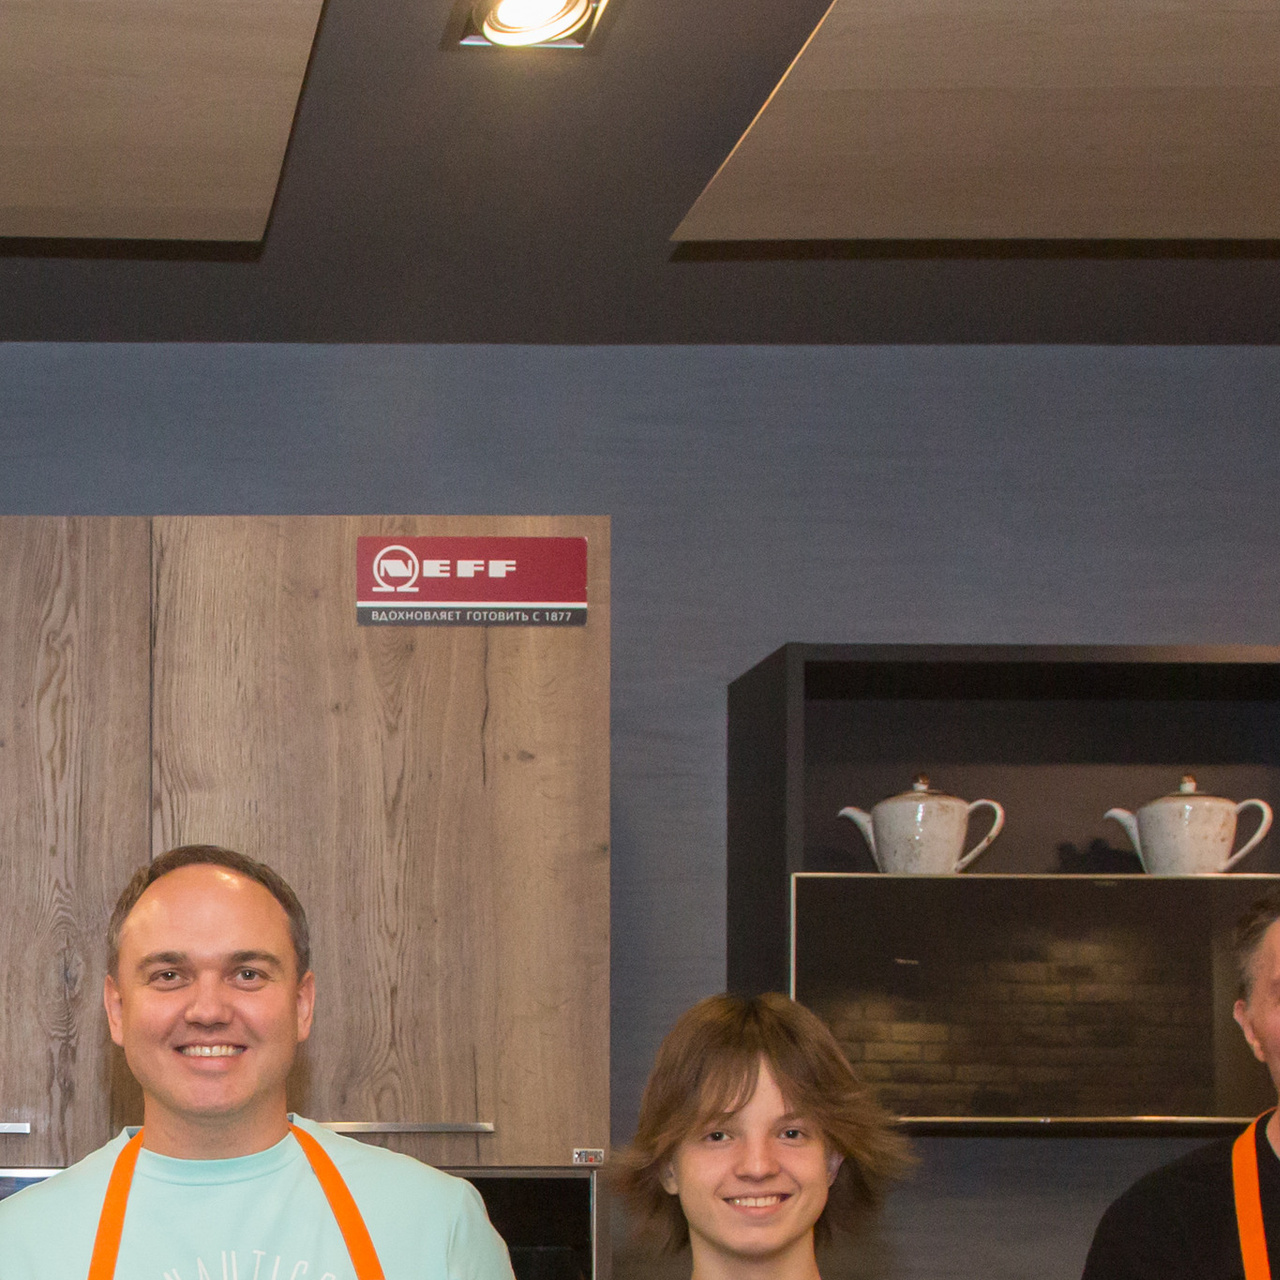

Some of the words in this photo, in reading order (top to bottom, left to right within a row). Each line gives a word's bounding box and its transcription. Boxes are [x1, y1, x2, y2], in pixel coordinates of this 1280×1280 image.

[371, 610, 462, 622] ВДОХНОВЛЯЕТ
[466, 611, 529, 622] ГОТОВИТЬ
[532, 611, 541, 622] С
[545, 611, 572, 622] 1877
